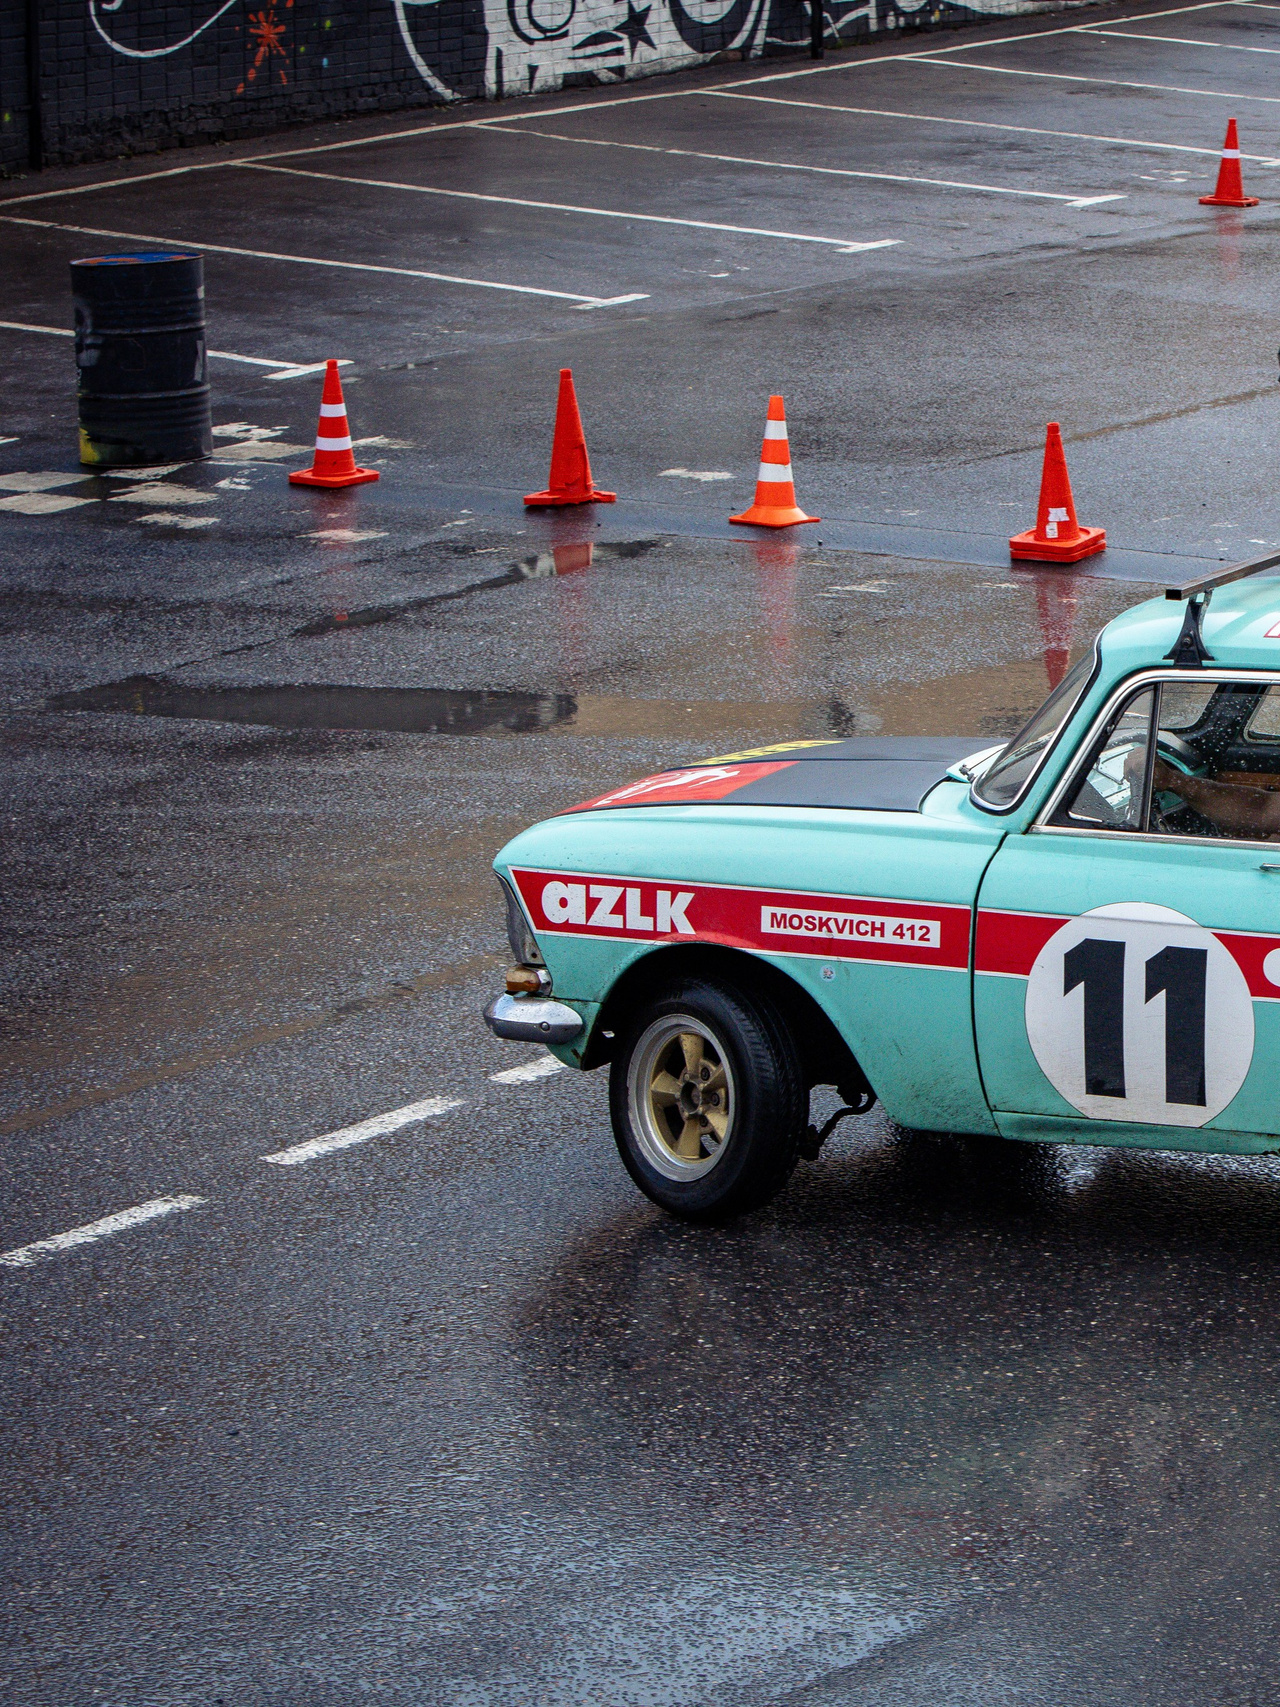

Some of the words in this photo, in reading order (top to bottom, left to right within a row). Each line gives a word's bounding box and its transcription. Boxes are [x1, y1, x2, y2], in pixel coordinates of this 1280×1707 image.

[770, 912, 886, 938] MOSKVICH
[892, 923, 931, 942] 412
[1063, 938, 1208, 1107] 11
